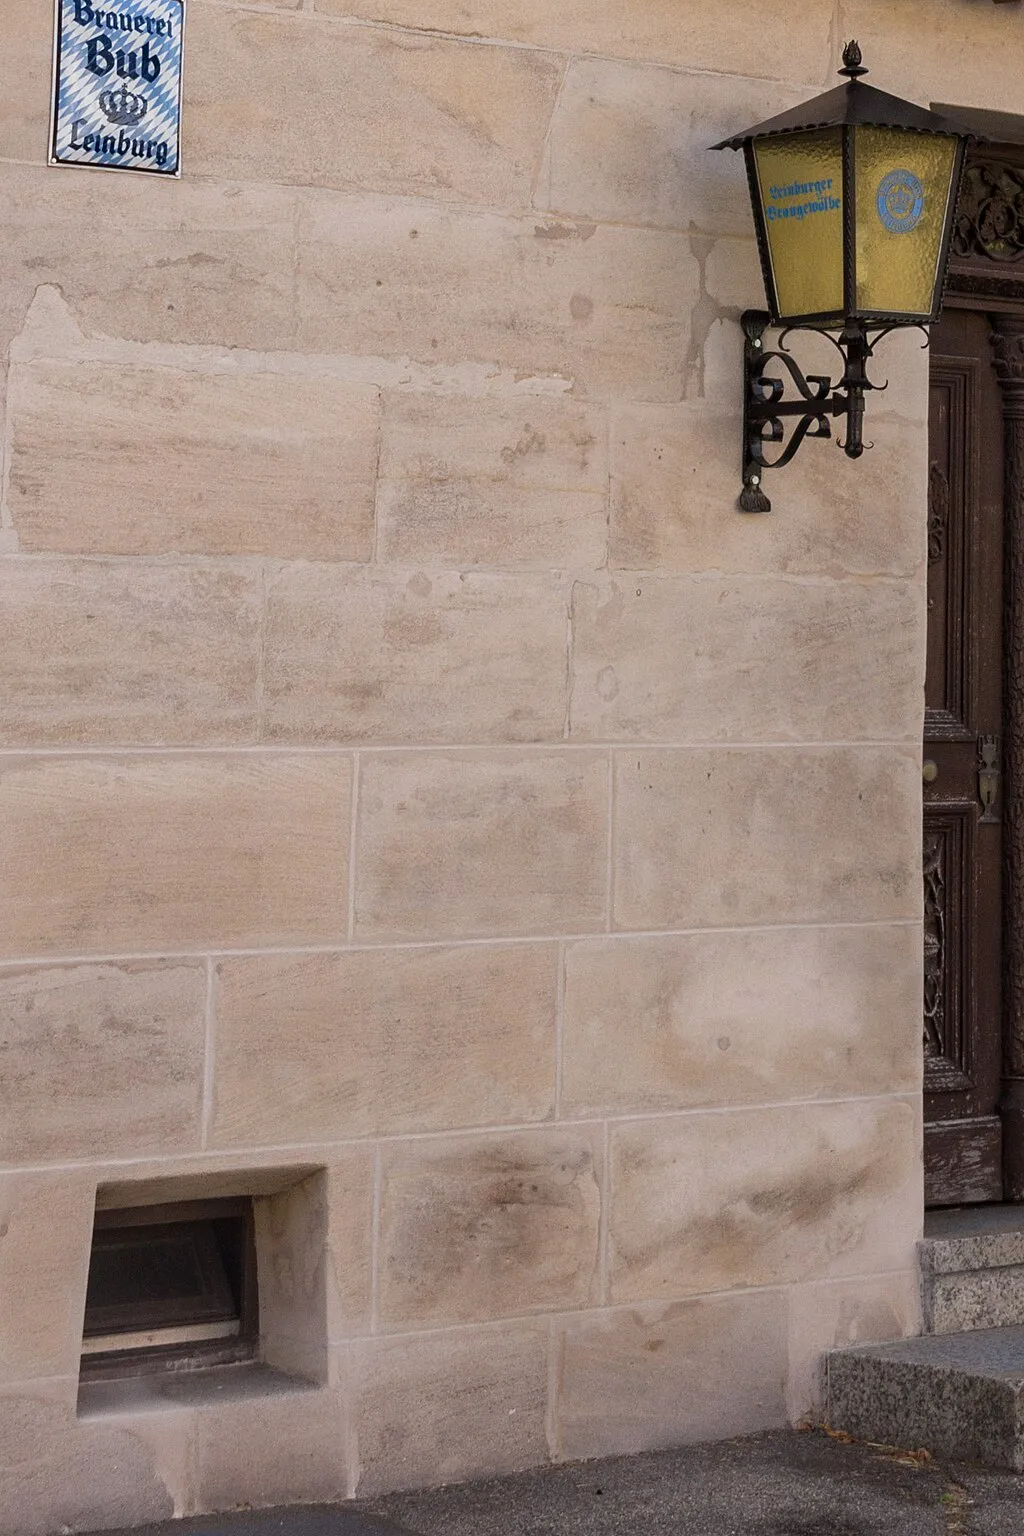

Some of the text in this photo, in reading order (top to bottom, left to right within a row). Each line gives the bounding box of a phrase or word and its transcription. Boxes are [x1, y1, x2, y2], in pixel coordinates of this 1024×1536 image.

[84, 33, 161, 83] Bub
[67, 117, 168, 166] Leinburg
[769, 178, 833, 199] Leinburger
[767, 195, 841, 221] Braugewölbe
